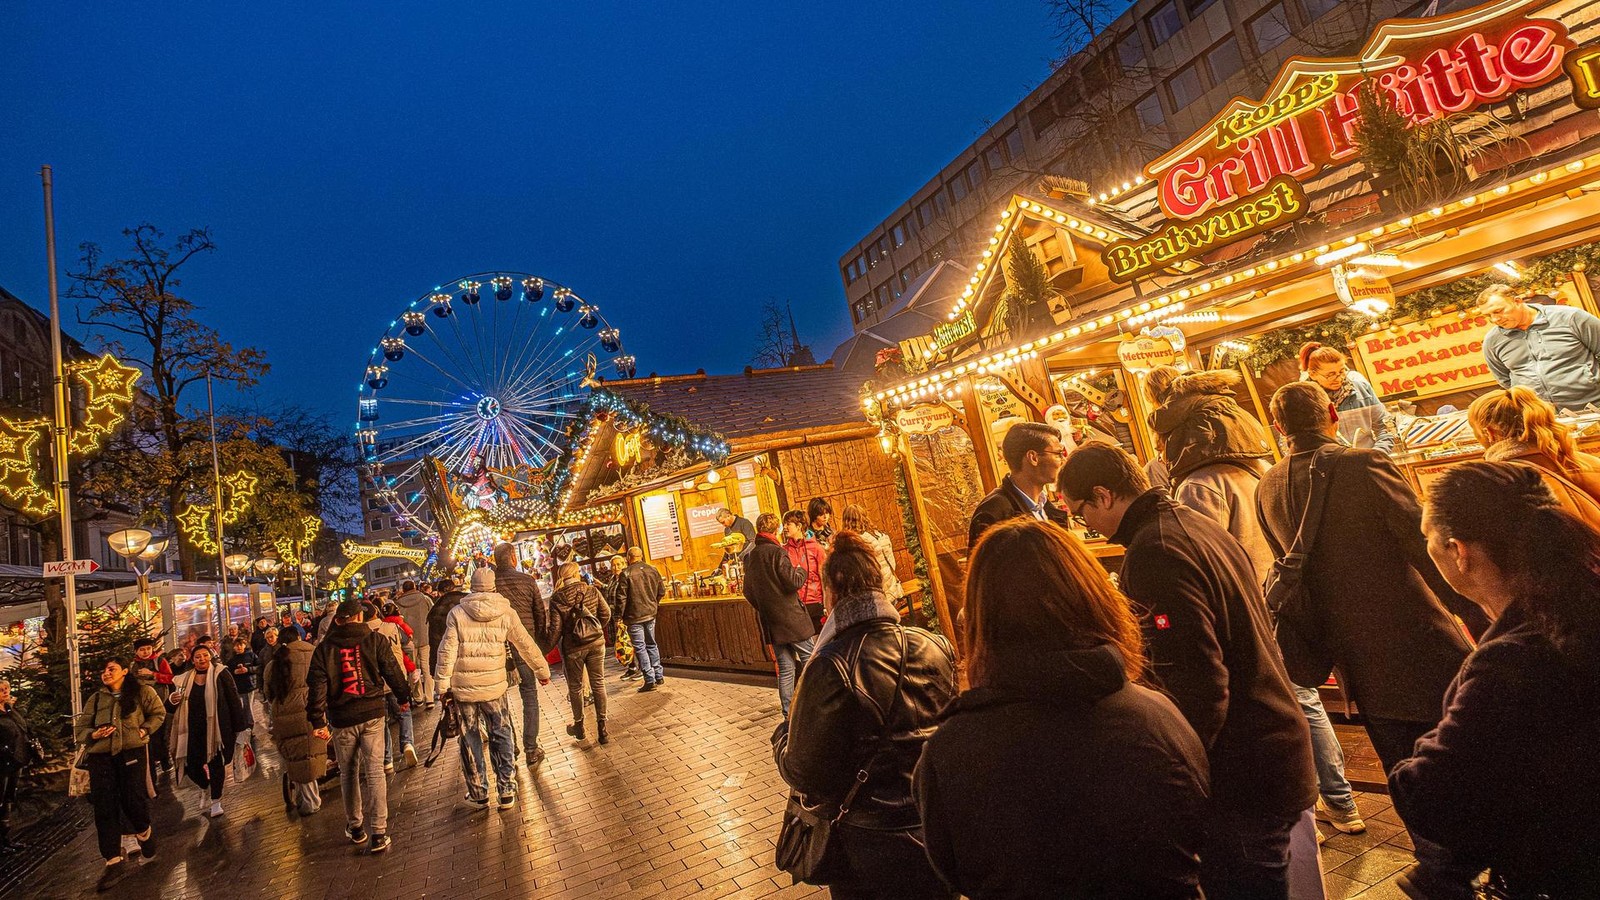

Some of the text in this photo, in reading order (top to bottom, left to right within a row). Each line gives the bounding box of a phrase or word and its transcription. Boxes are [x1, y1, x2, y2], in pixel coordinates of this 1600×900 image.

[1163, 26, 1564, 221] Grill Hütte
[1214, 72, 1339, 149] Kropp's
[1107, 182, 1300, 278] Bratwurst
[1351, 285, 1392, 297] Bratwurst
[1365, 316, 1487, 354] Bratwurs
[1121, 349, 1173, 361] Mettwurst
[1372, 340, 1484, 374] Krakaue
[1380, 363, 1490, 395] Mettwur
[899, 411, 951, 427] Currywurst
[48, 562, 68, 573] WC
[352, 546, 424, 557] FROHE WEIHNACHTEN
